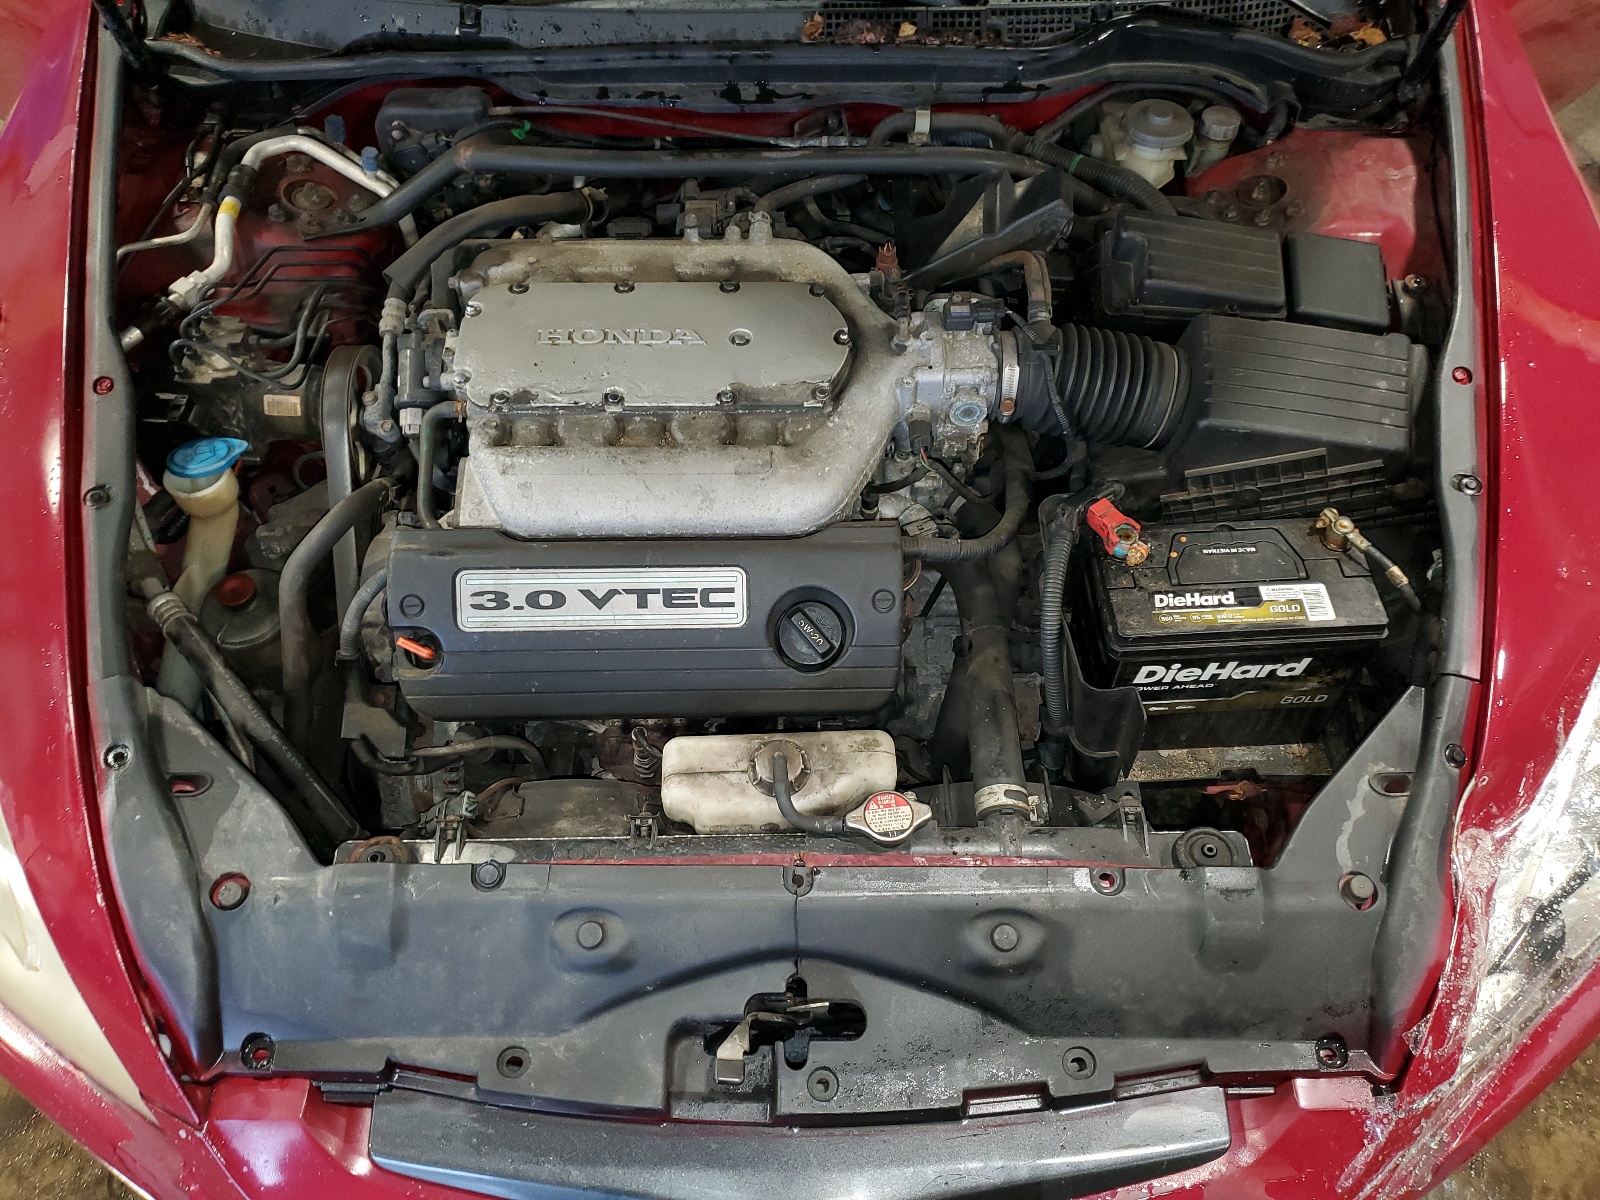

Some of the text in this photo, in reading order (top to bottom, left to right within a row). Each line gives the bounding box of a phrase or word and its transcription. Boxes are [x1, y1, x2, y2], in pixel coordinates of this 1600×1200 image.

[536, 328, 707, 345] HONDA
[469, 587, 736, 611] 3.0 VTEC
[1153, 591, 1235, 608] DieHard
[1269, 603, 1301, 613] GOLD
[798, 619, 824, 646] 5W-20
[1132, 657, 1314, 684] DieHard
[1280, 694, 1329, 705] GOLD
